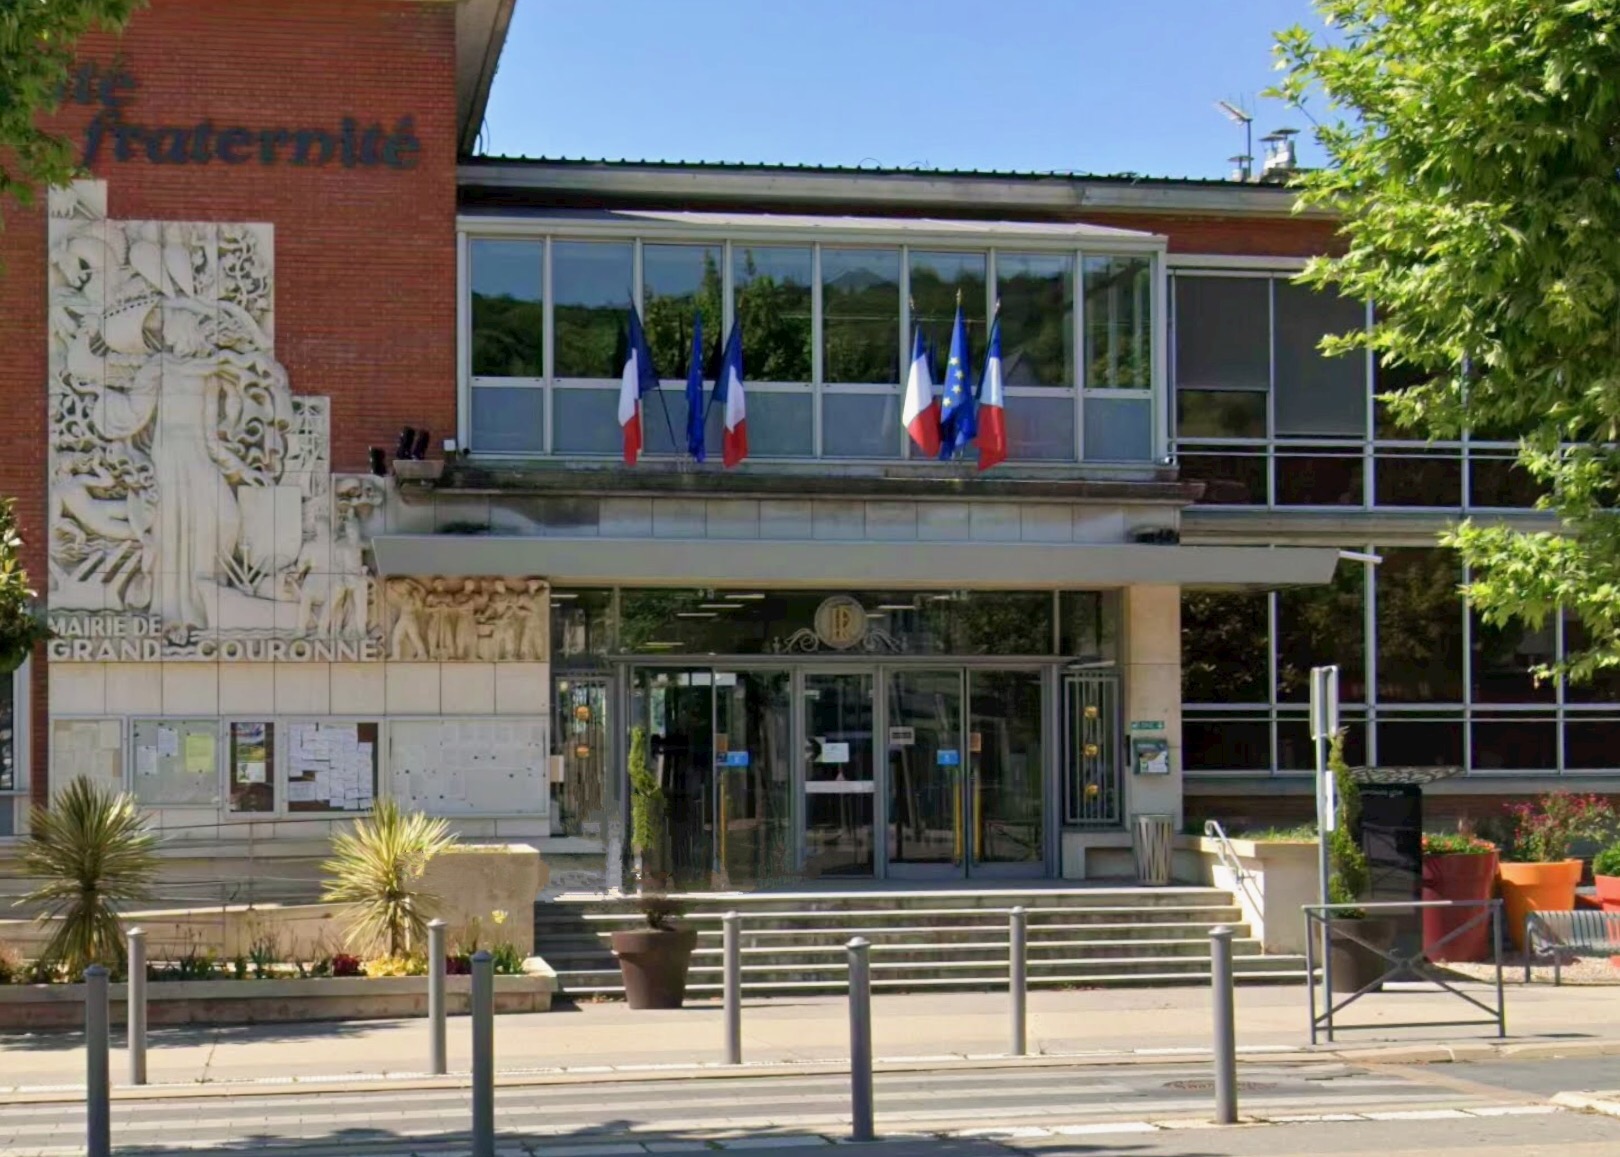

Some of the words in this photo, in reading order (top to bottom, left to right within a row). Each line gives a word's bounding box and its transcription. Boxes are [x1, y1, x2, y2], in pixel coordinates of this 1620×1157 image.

[82, 109, 421, 169] fraternité
[48, 616, 127, 637] MAIRIE
[133, 616, 161, 637] DE
[47, 639, 162, 661] GRAND
[196, 639, 378, 661] COURONNE
